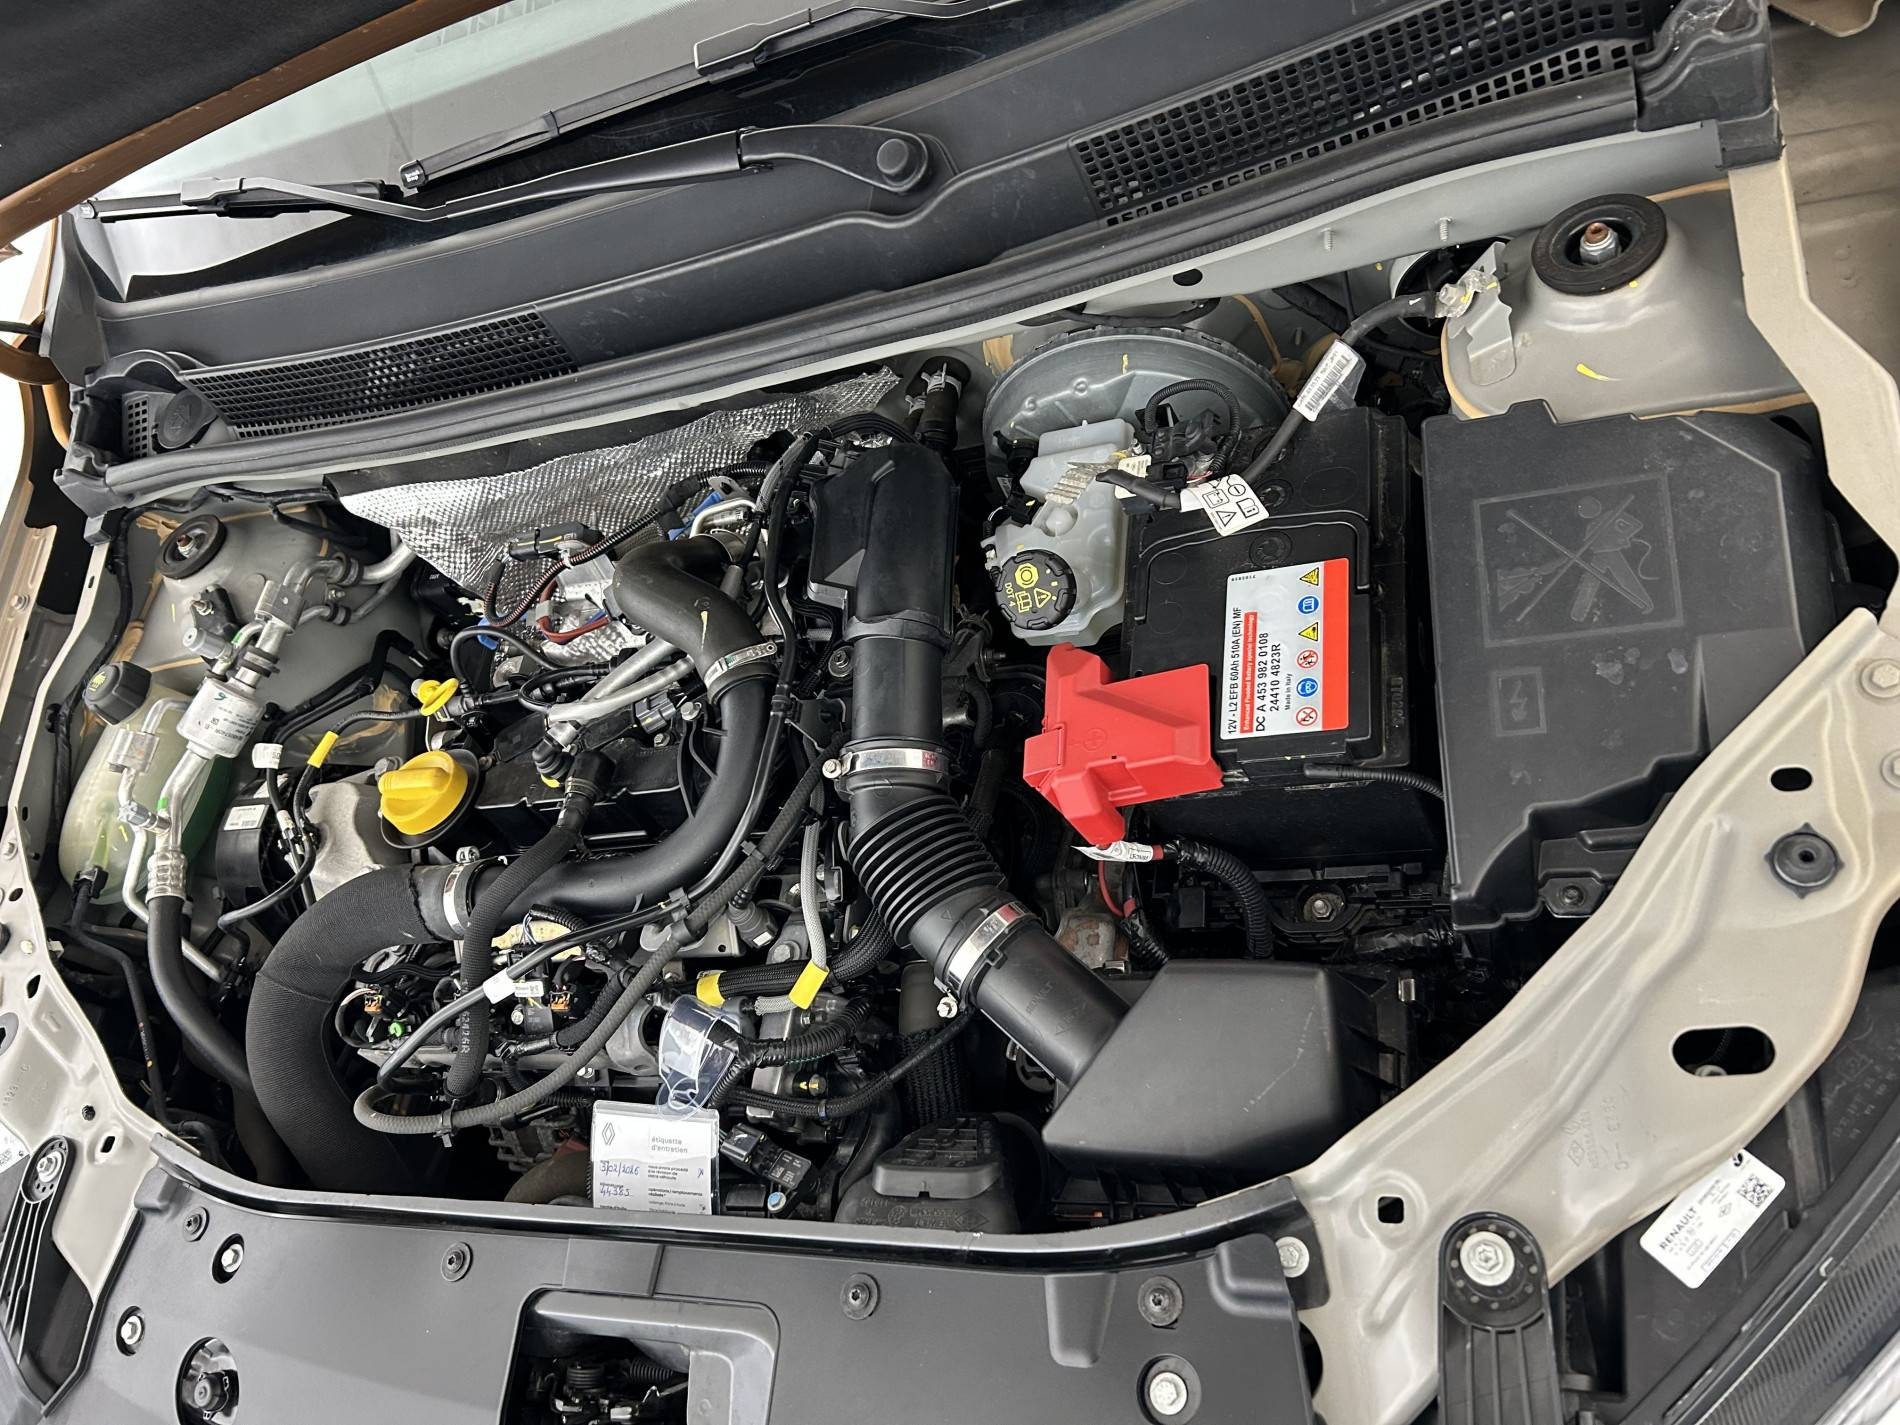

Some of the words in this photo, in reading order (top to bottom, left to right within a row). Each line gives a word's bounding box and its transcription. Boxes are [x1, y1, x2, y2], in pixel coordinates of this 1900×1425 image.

[1005, 582, 1014, 598] DOT
[1232, 607, 1242, 620] MF
[1232, 621, 1243, 640] (EN)
[1231, 639, 1240, 659] 510A
[1258, 632, 1269, 657] 0108
[1257, 660, 1268, 679] 982
[1270, 643, 1281, 677] 4823R
[1230, 660, 1240, 681] 60Ah
[1245, 662, 1253, 681] Battery
[1285, 673, 1293, 686] Italy
[1229, 682, 1239, 702] EFB
[1257, 682, 1268, 701] 453
[1269, 679, 1280, 712] 24410
[1229, 702, 1238, 713] L2
[1257, 703, 1267, 712] A
[1284, 694, 1292, 711] Made
[1228, 719, 1237, 734] 12V
[1243, 703, 1251, 731] Enhanced
[1255, 716, 1266, 732] DC
[651, 1136, 682, 1145] étiquette
[651, 1145, 688, 1153] d'entretien
[1659, 1207, 1697, 1250] RENAULT
